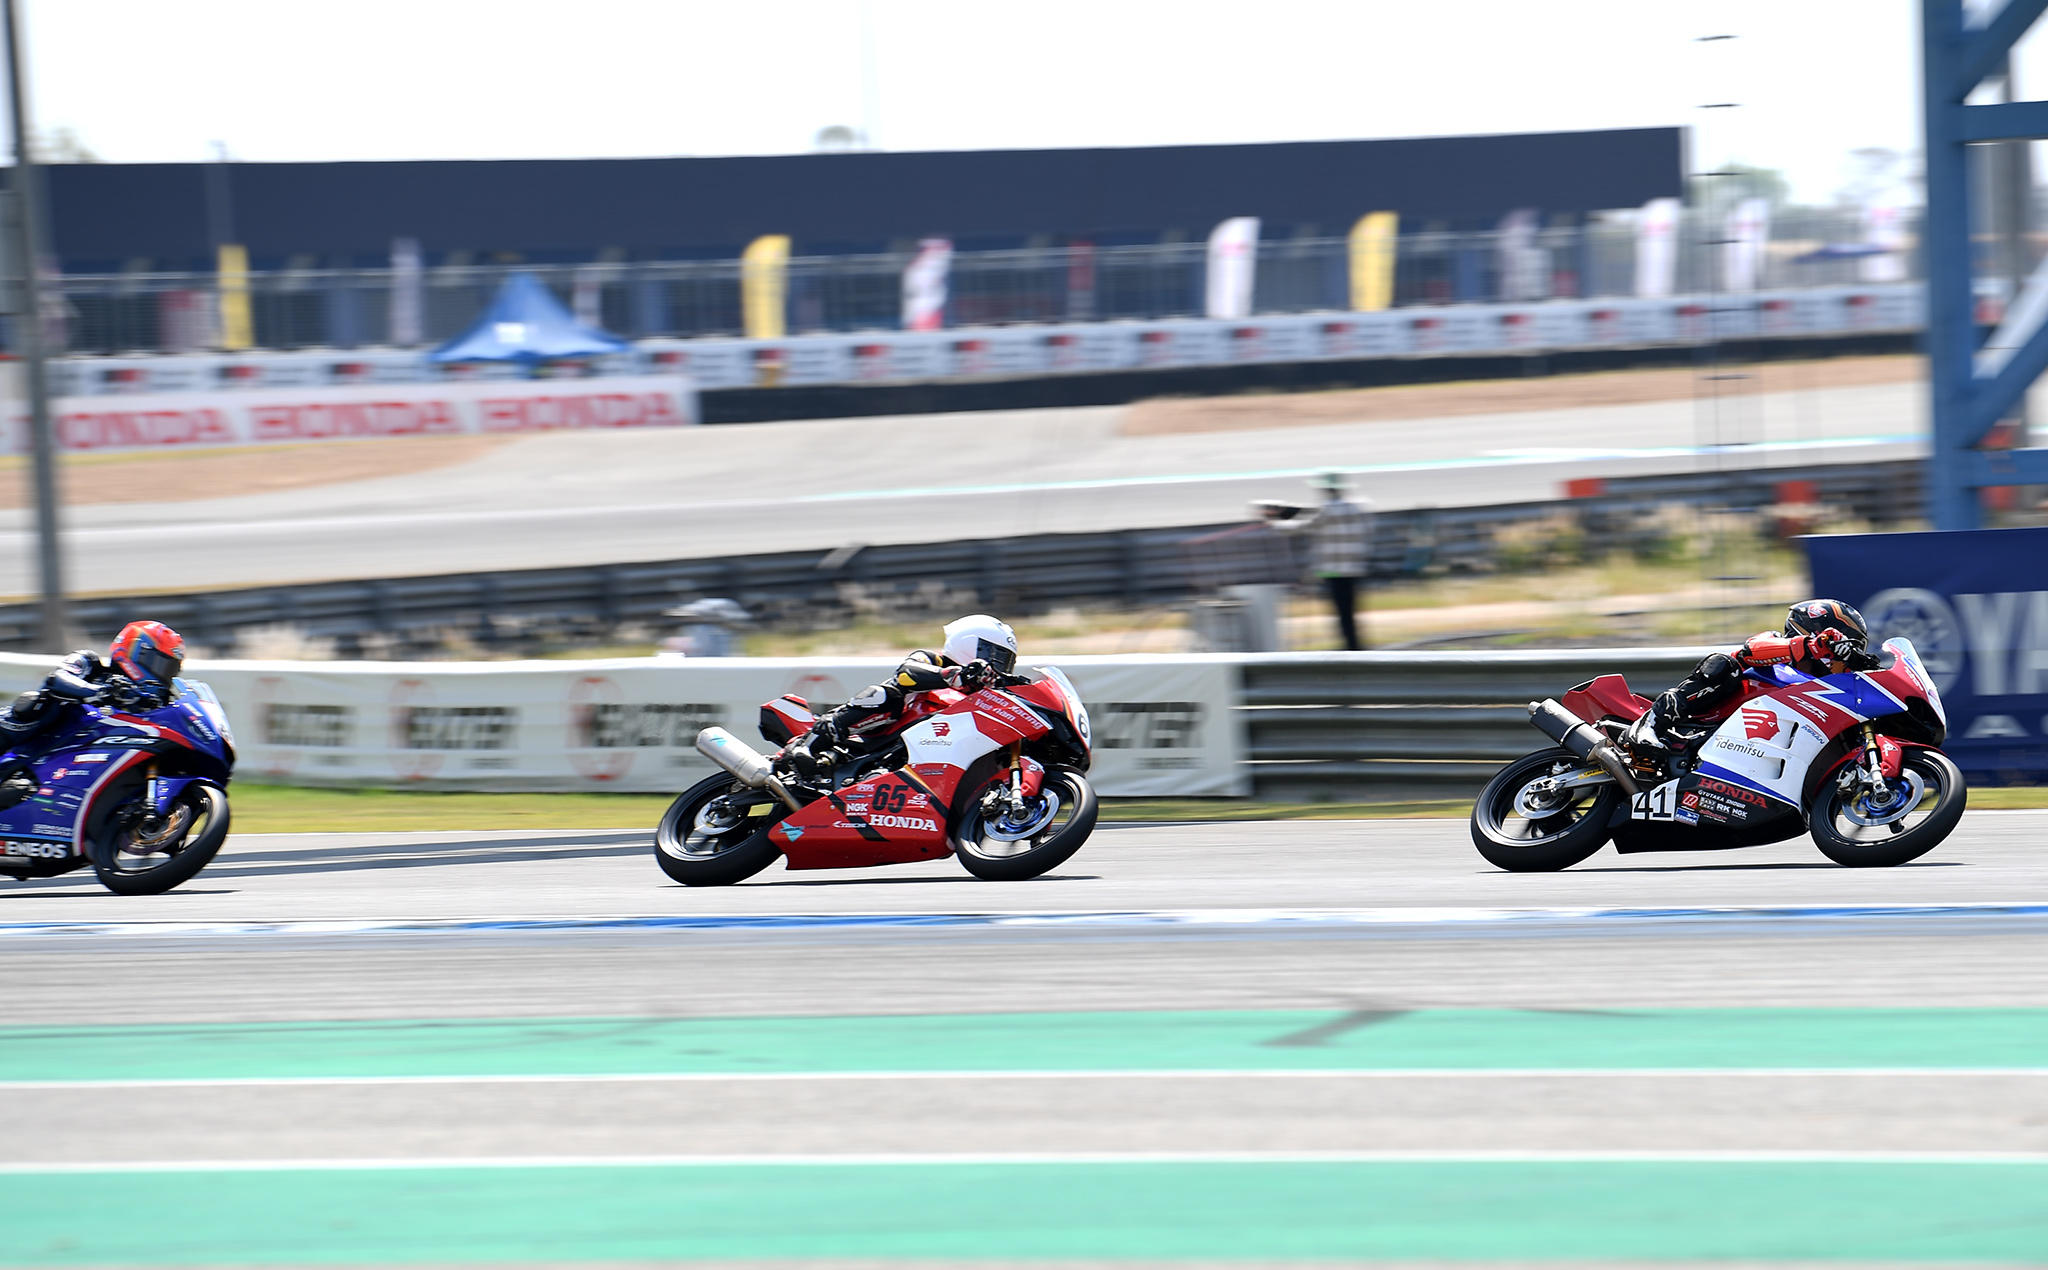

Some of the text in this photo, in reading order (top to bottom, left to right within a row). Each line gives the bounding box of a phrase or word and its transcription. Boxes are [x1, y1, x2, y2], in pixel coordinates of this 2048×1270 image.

[247, 400, 464, 440] HONDA
[478, 391, 687, 430] HONDA
[977, 688, 1010, 708] Honda
[918, 737, 953, 747] idemitsu
[1716, 739, 1765, 758] idemitsu
[872, 783, 910, 814] 65
[1698, 777, 1768, 809] HONDA
[846, 802, 869, 812] NGK
[1633, 786, 1672, 820] 41
[1716, 802, 1731, 813] RK
[868, 814, 939, 832] HONDA
[5, 840, 67, 858] ENEOS
